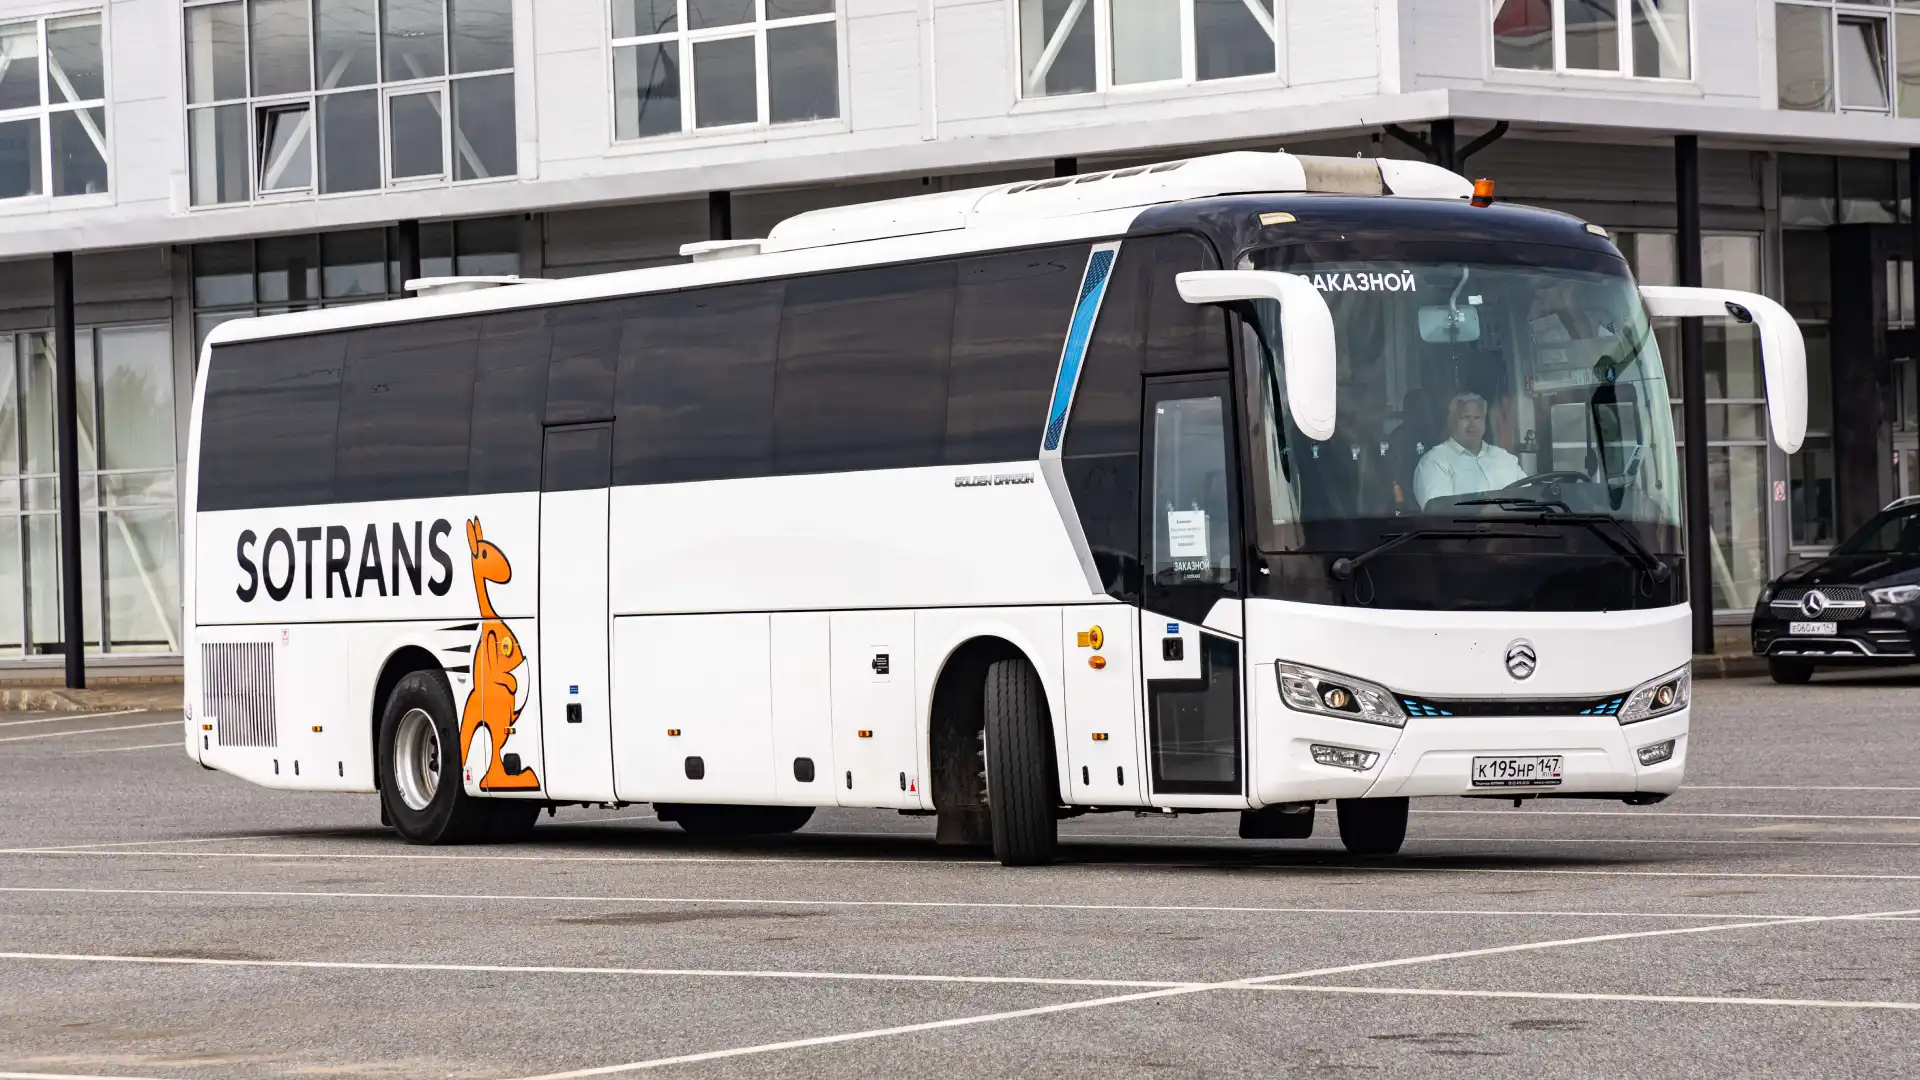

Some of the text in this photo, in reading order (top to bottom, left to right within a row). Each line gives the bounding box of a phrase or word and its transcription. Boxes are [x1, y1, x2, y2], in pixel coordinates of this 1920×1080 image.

[954, 473, 1034, 487] GOLDEN DRAGON
[236, 518, 453, 602] SOTRANS
[1174, 559, 1210, 571] ЗАКАЗНОЙ
[1538, 759, 1559, 772] 147
